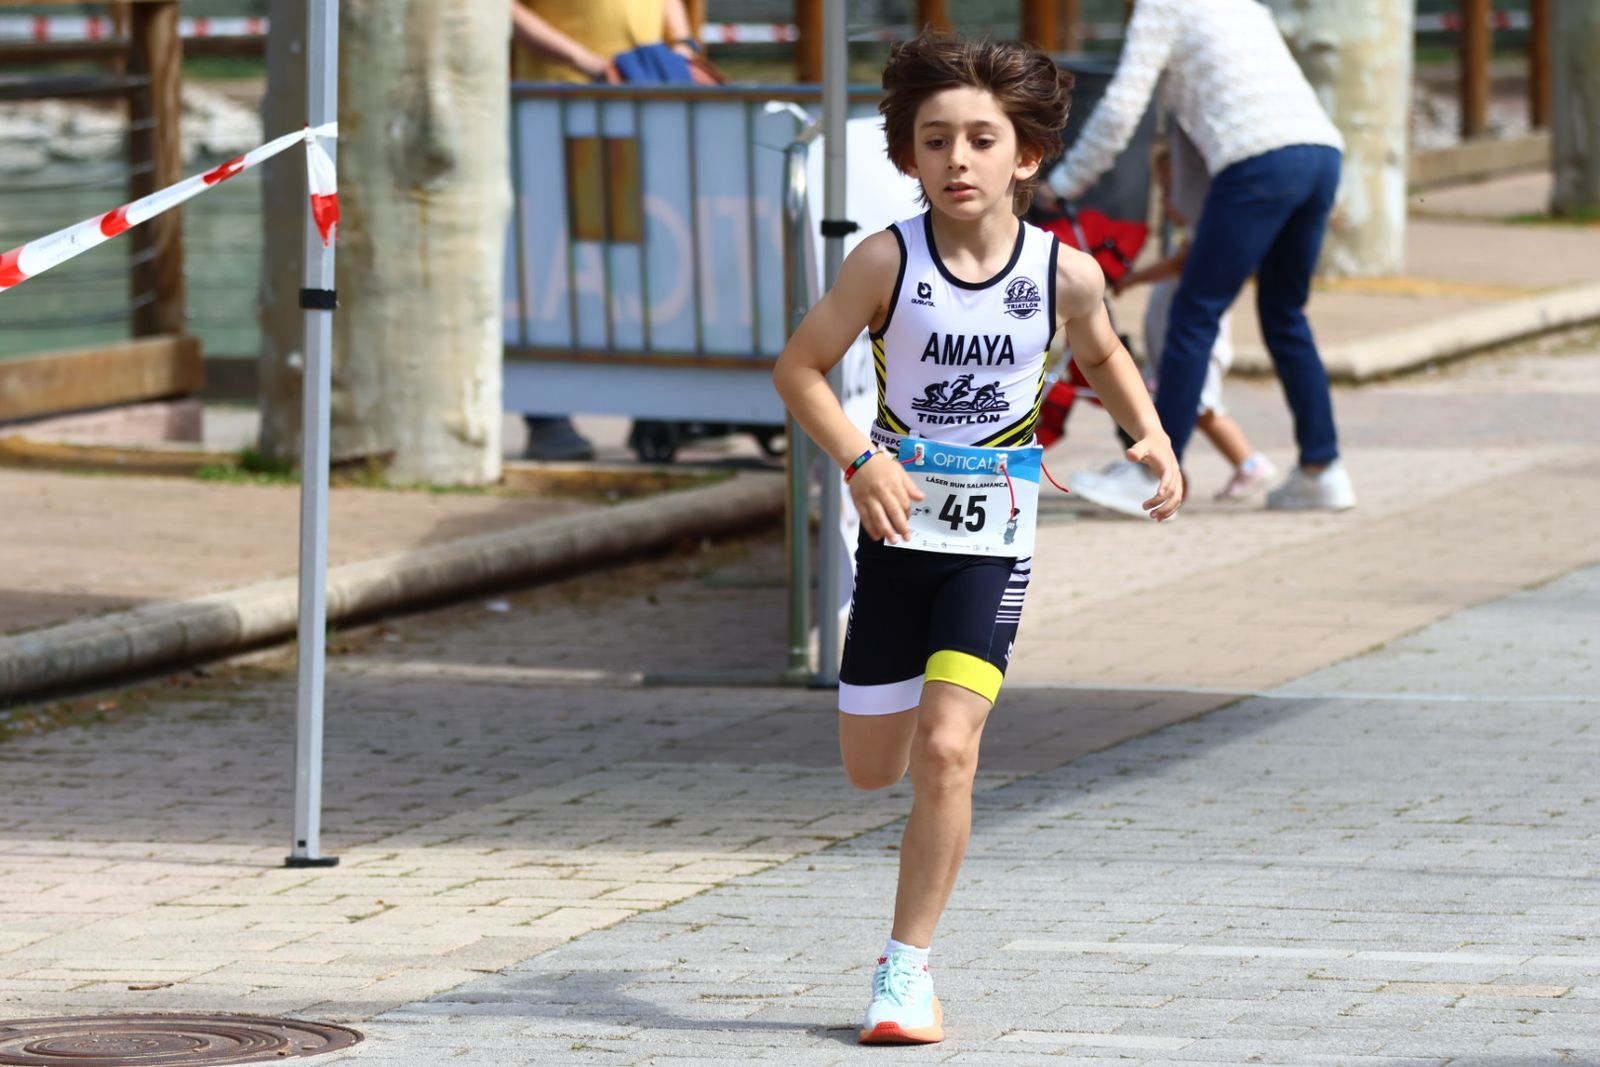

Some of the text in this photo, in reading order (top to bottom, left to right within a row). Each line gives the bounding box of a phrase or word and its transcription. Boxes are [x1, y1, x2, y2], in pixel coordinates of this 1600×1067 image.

[1007, 302, 1038, 310] TRIATLÓN
[920, 332, 1015, 366] AMAYA
[917, 412, 1001, 425] TRIATLÓN
[926, 476, 949, 487] LÁSER
[949, 481, 966, 489] RUN
[938, 494, 988, 533] 45
